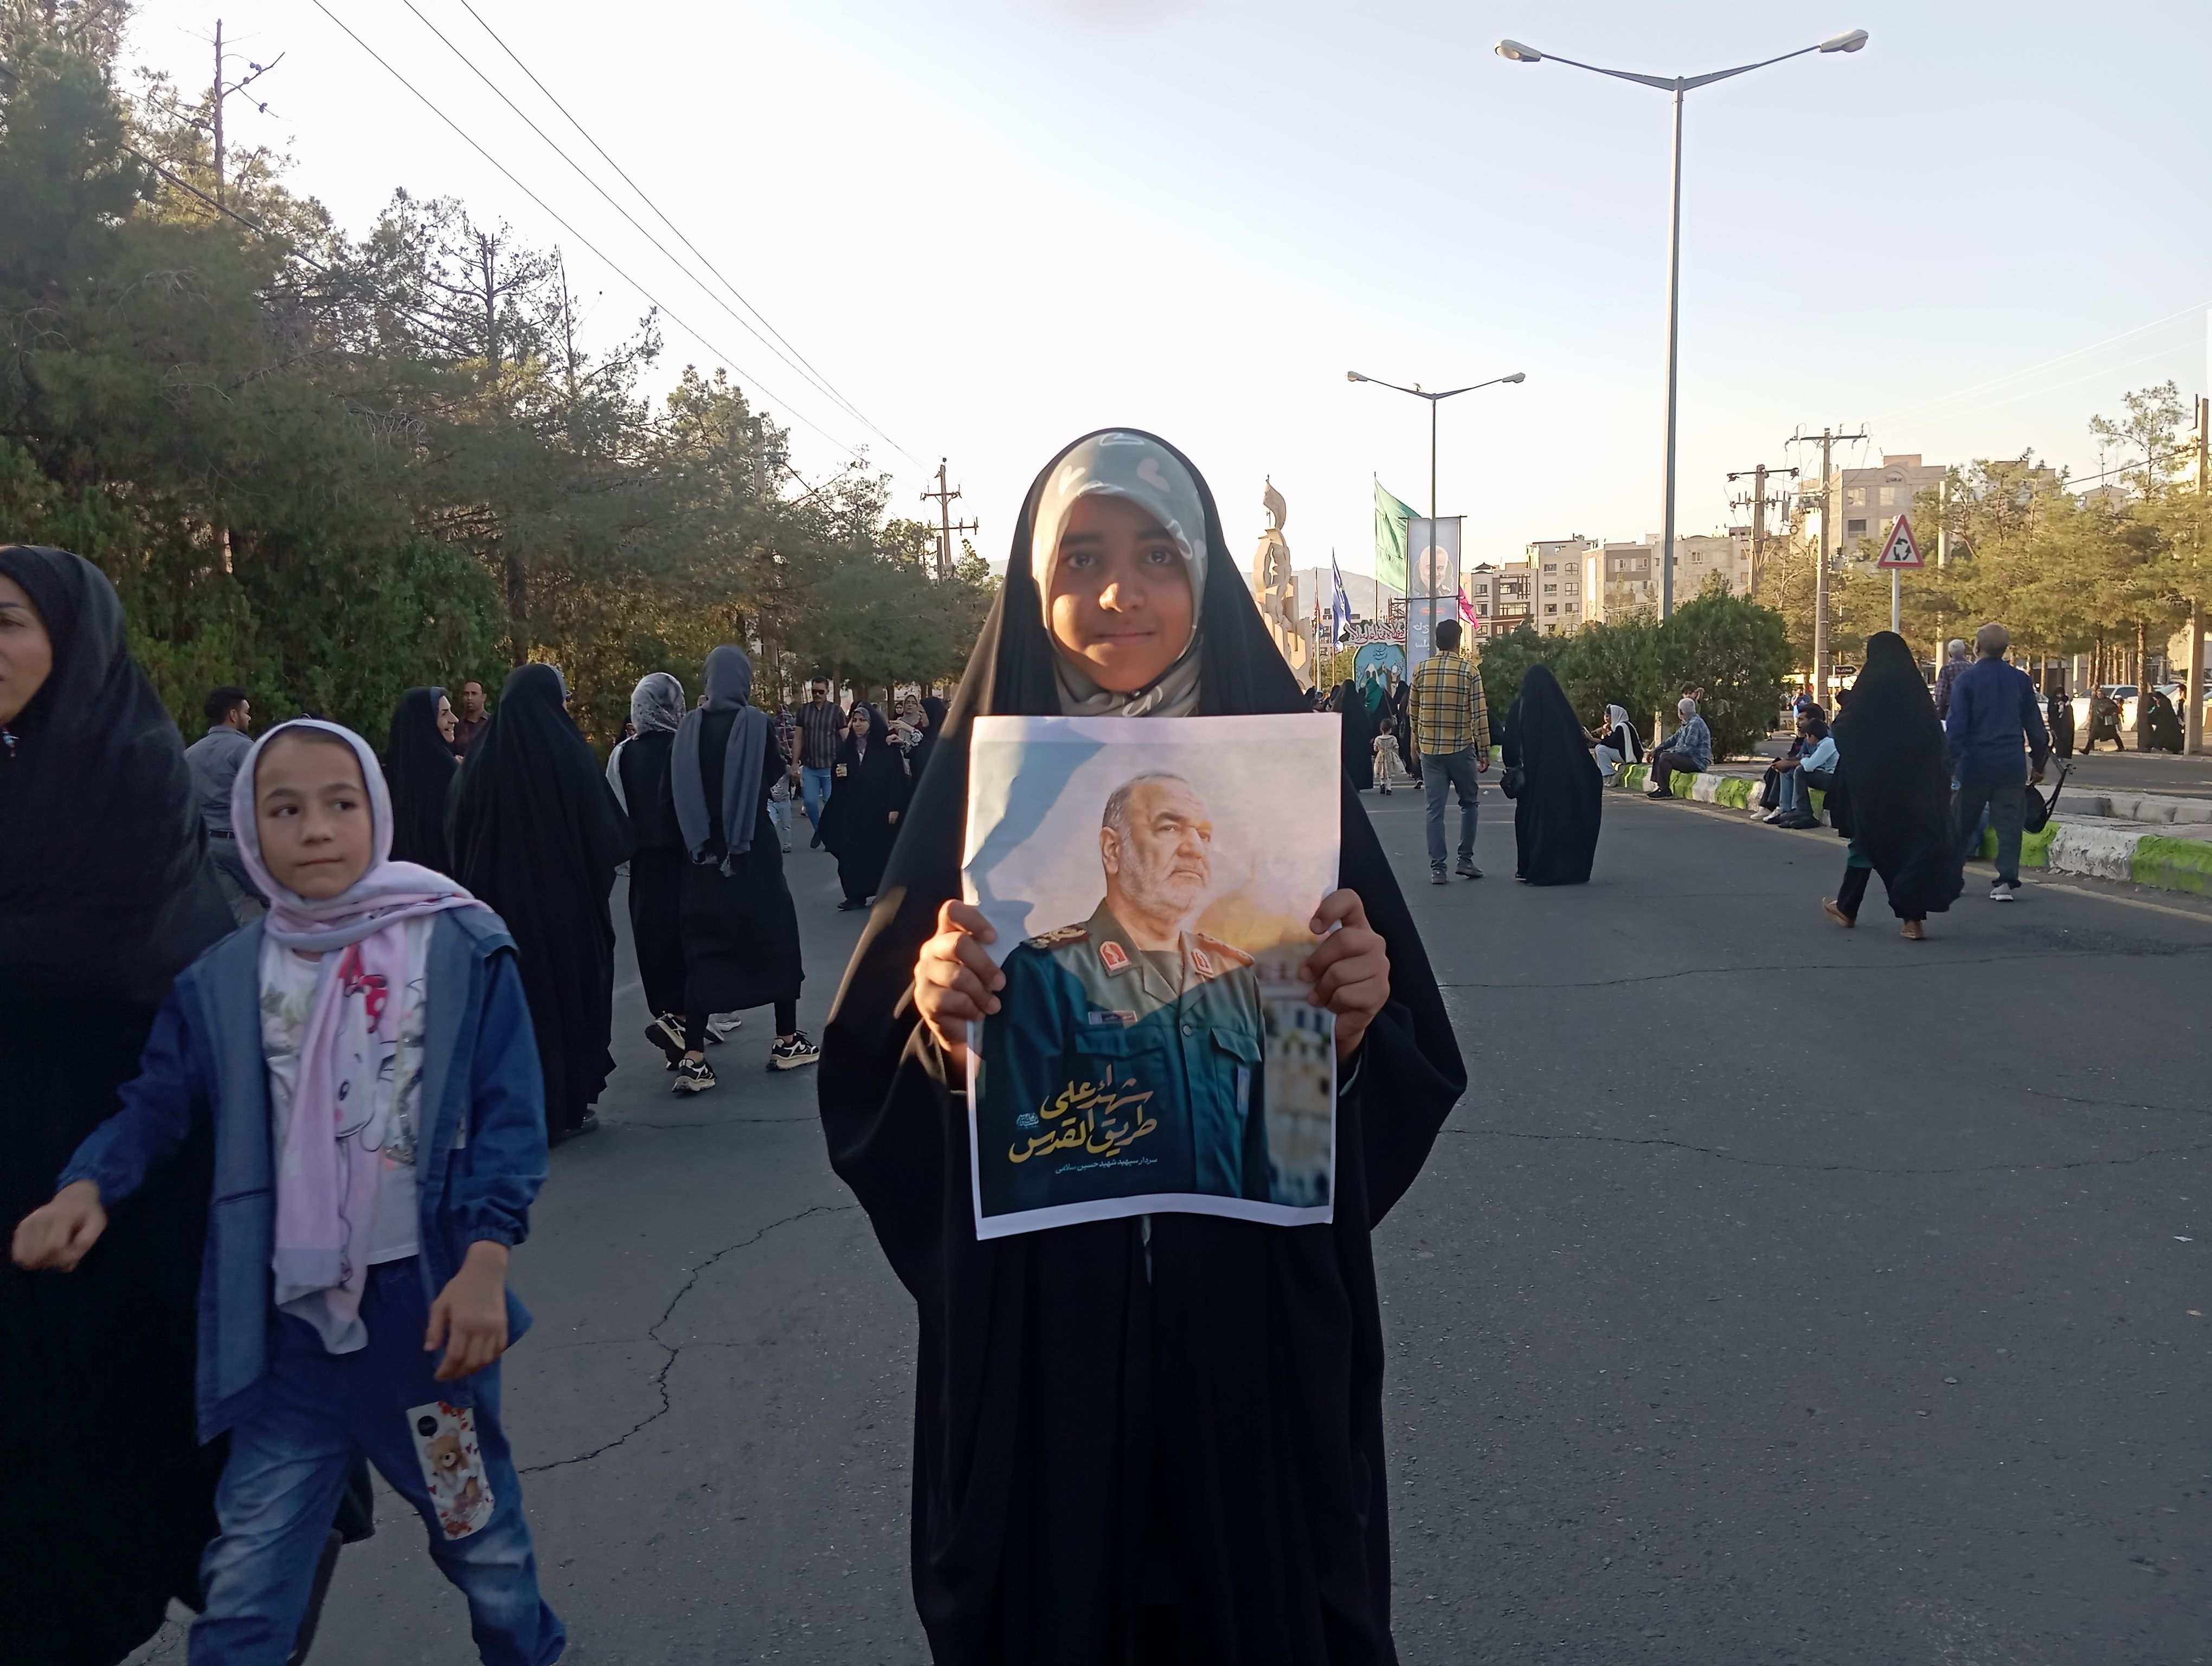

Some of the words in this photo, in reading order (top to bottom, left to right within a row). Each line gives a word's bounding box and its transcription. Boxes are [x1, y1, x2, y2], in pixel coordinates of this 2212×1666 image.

[1008, 1108, 1095, 1163] القدس
[1086, 1104, 1158, 1157] طریق
[1099, 1159, 1117, 1168] شهید
[1138, 1156, 1158, 1165] سردار
[1055, 1163, 1077, 1174] سلامی
[1077, 1162, 1098, 1171] حسین
